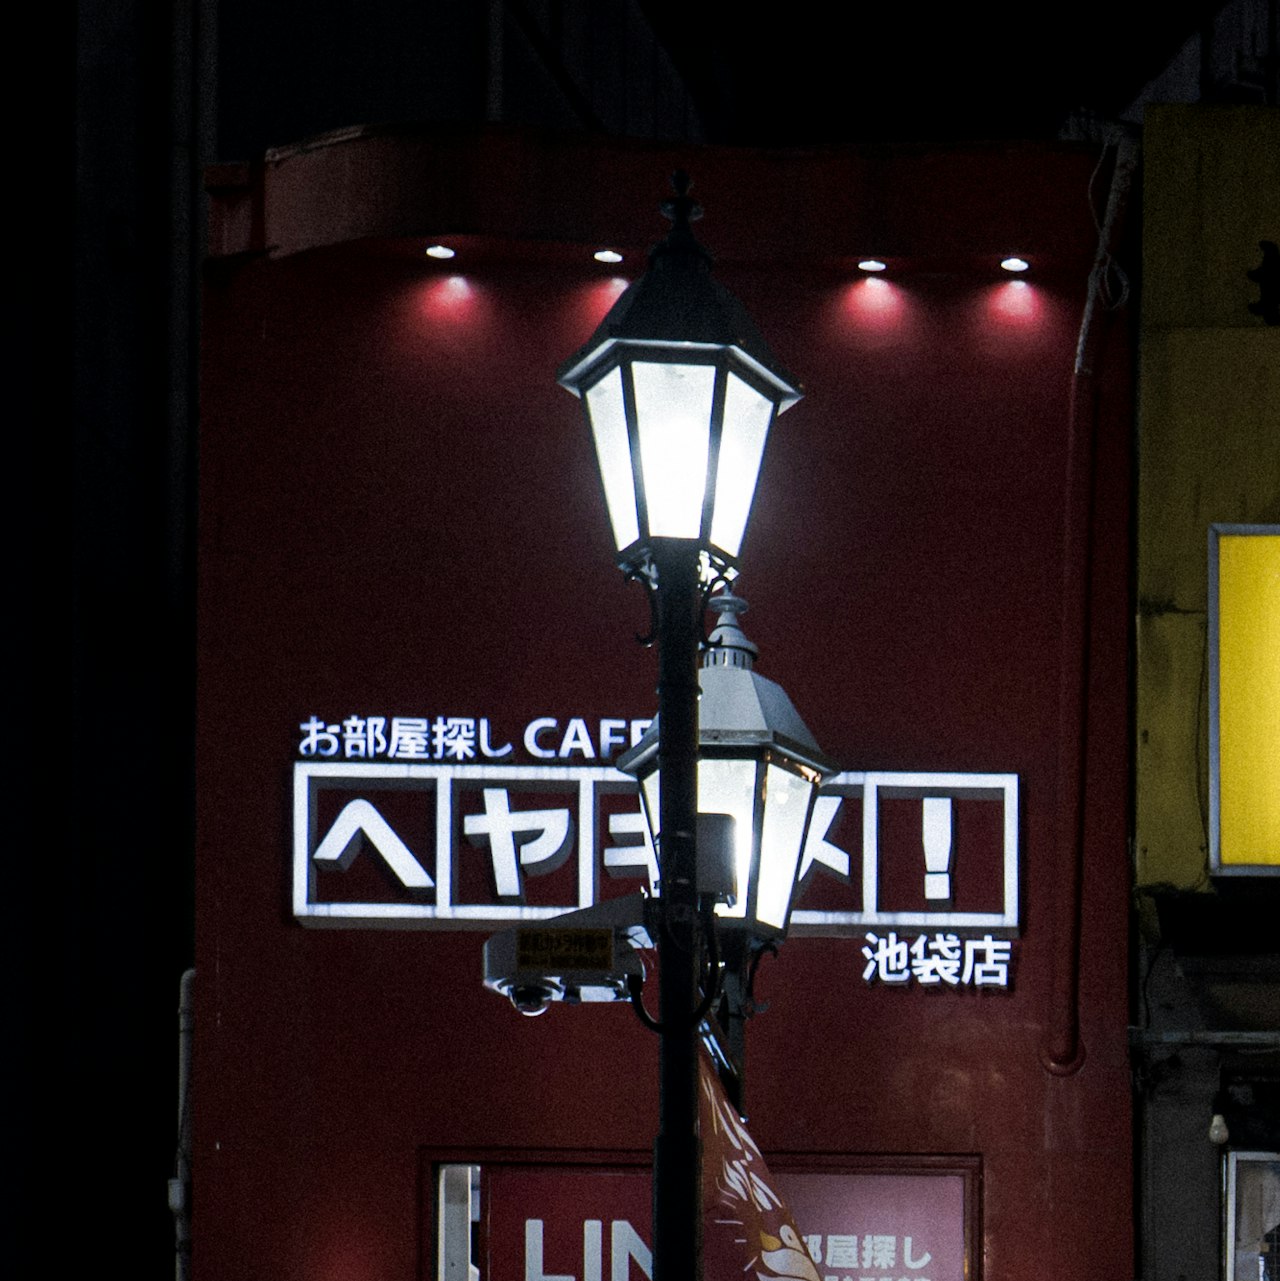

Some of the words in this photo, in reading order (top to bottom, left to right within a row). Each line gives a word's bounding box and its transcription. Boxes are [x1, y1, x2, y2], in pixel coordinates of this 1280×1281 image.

[298, 714, 513, 761] お部屋探し
[861, 932, 1012, 987] 池袋店
